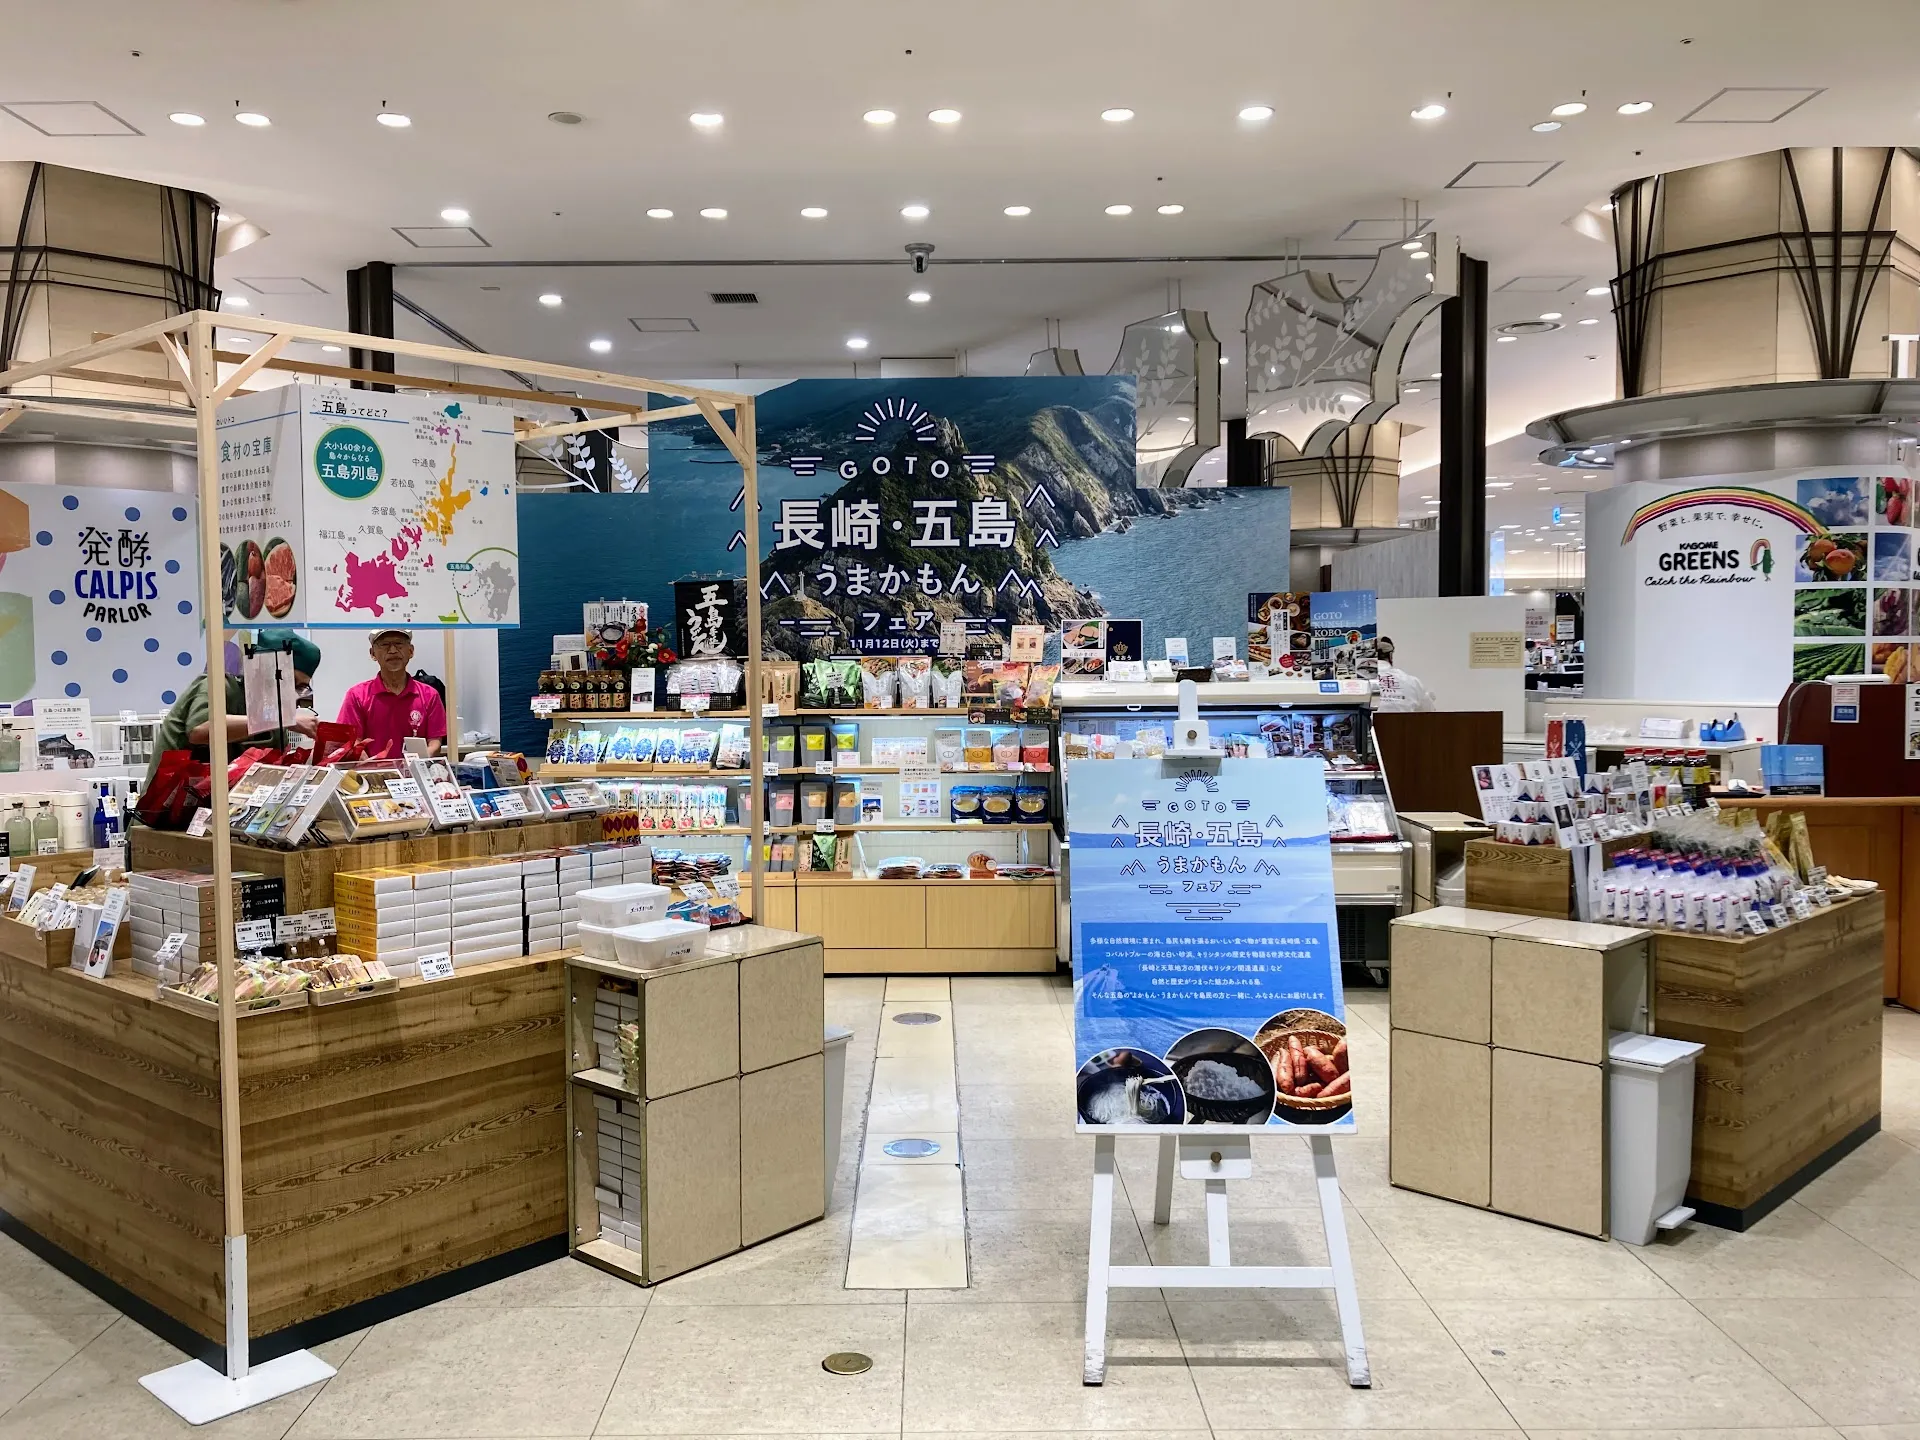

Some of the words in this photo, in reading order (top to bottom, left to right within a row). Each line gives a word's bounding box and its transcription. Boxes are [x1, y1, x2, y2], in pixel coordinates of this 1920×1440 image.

[221, 436, 272, 463] 食材の宝庫
[324, 441, 374, 453] 大小140余りの
[328, 452, 370, 462] 島々からなる
[412, 458, 436, 469] 中通島
[320, 463, 380, 482] 五島列島
[839, 456, 950, 479] GOTO
[390, 478, 415, 489] 若松島
[371, 506, 396, 516] 奈留島
[774, 496, 1016, 551] 長崎・五島
[1657, 511, 1764, 532] 野菜と、果実で、幸せに。
[318, 529, 346, 540] 福江島
[358, 525, 384, 535] 久賀島
[78, 526, 152, 568] 発酵
[1679, 541, 1719, 551] KAGOME
[1659, 550, 1740, 572] GREENS
[74, 569, 158, 600] CALPIS
[815, 563, 981, 596] うまかもん
[1644, 576, 1677, 586] Catch
[1679, 575, 1697, 585] the
[1700, 574, 1756, 585] Rainbow
[83, 602, 152, 624] PARLOR
[862, 610, 935, 631] フェア
[1313, 611, 1343, 620] GOTO
[1314, 629, 1342, 638] KOBO
[1167, 800, 1227, 813] GOTO
[1134, 821, 1263, 848] 長崎・五島
[1157, 856, 1247, 874] うまかもん
[1182, 880, 1223, 892] フェア
